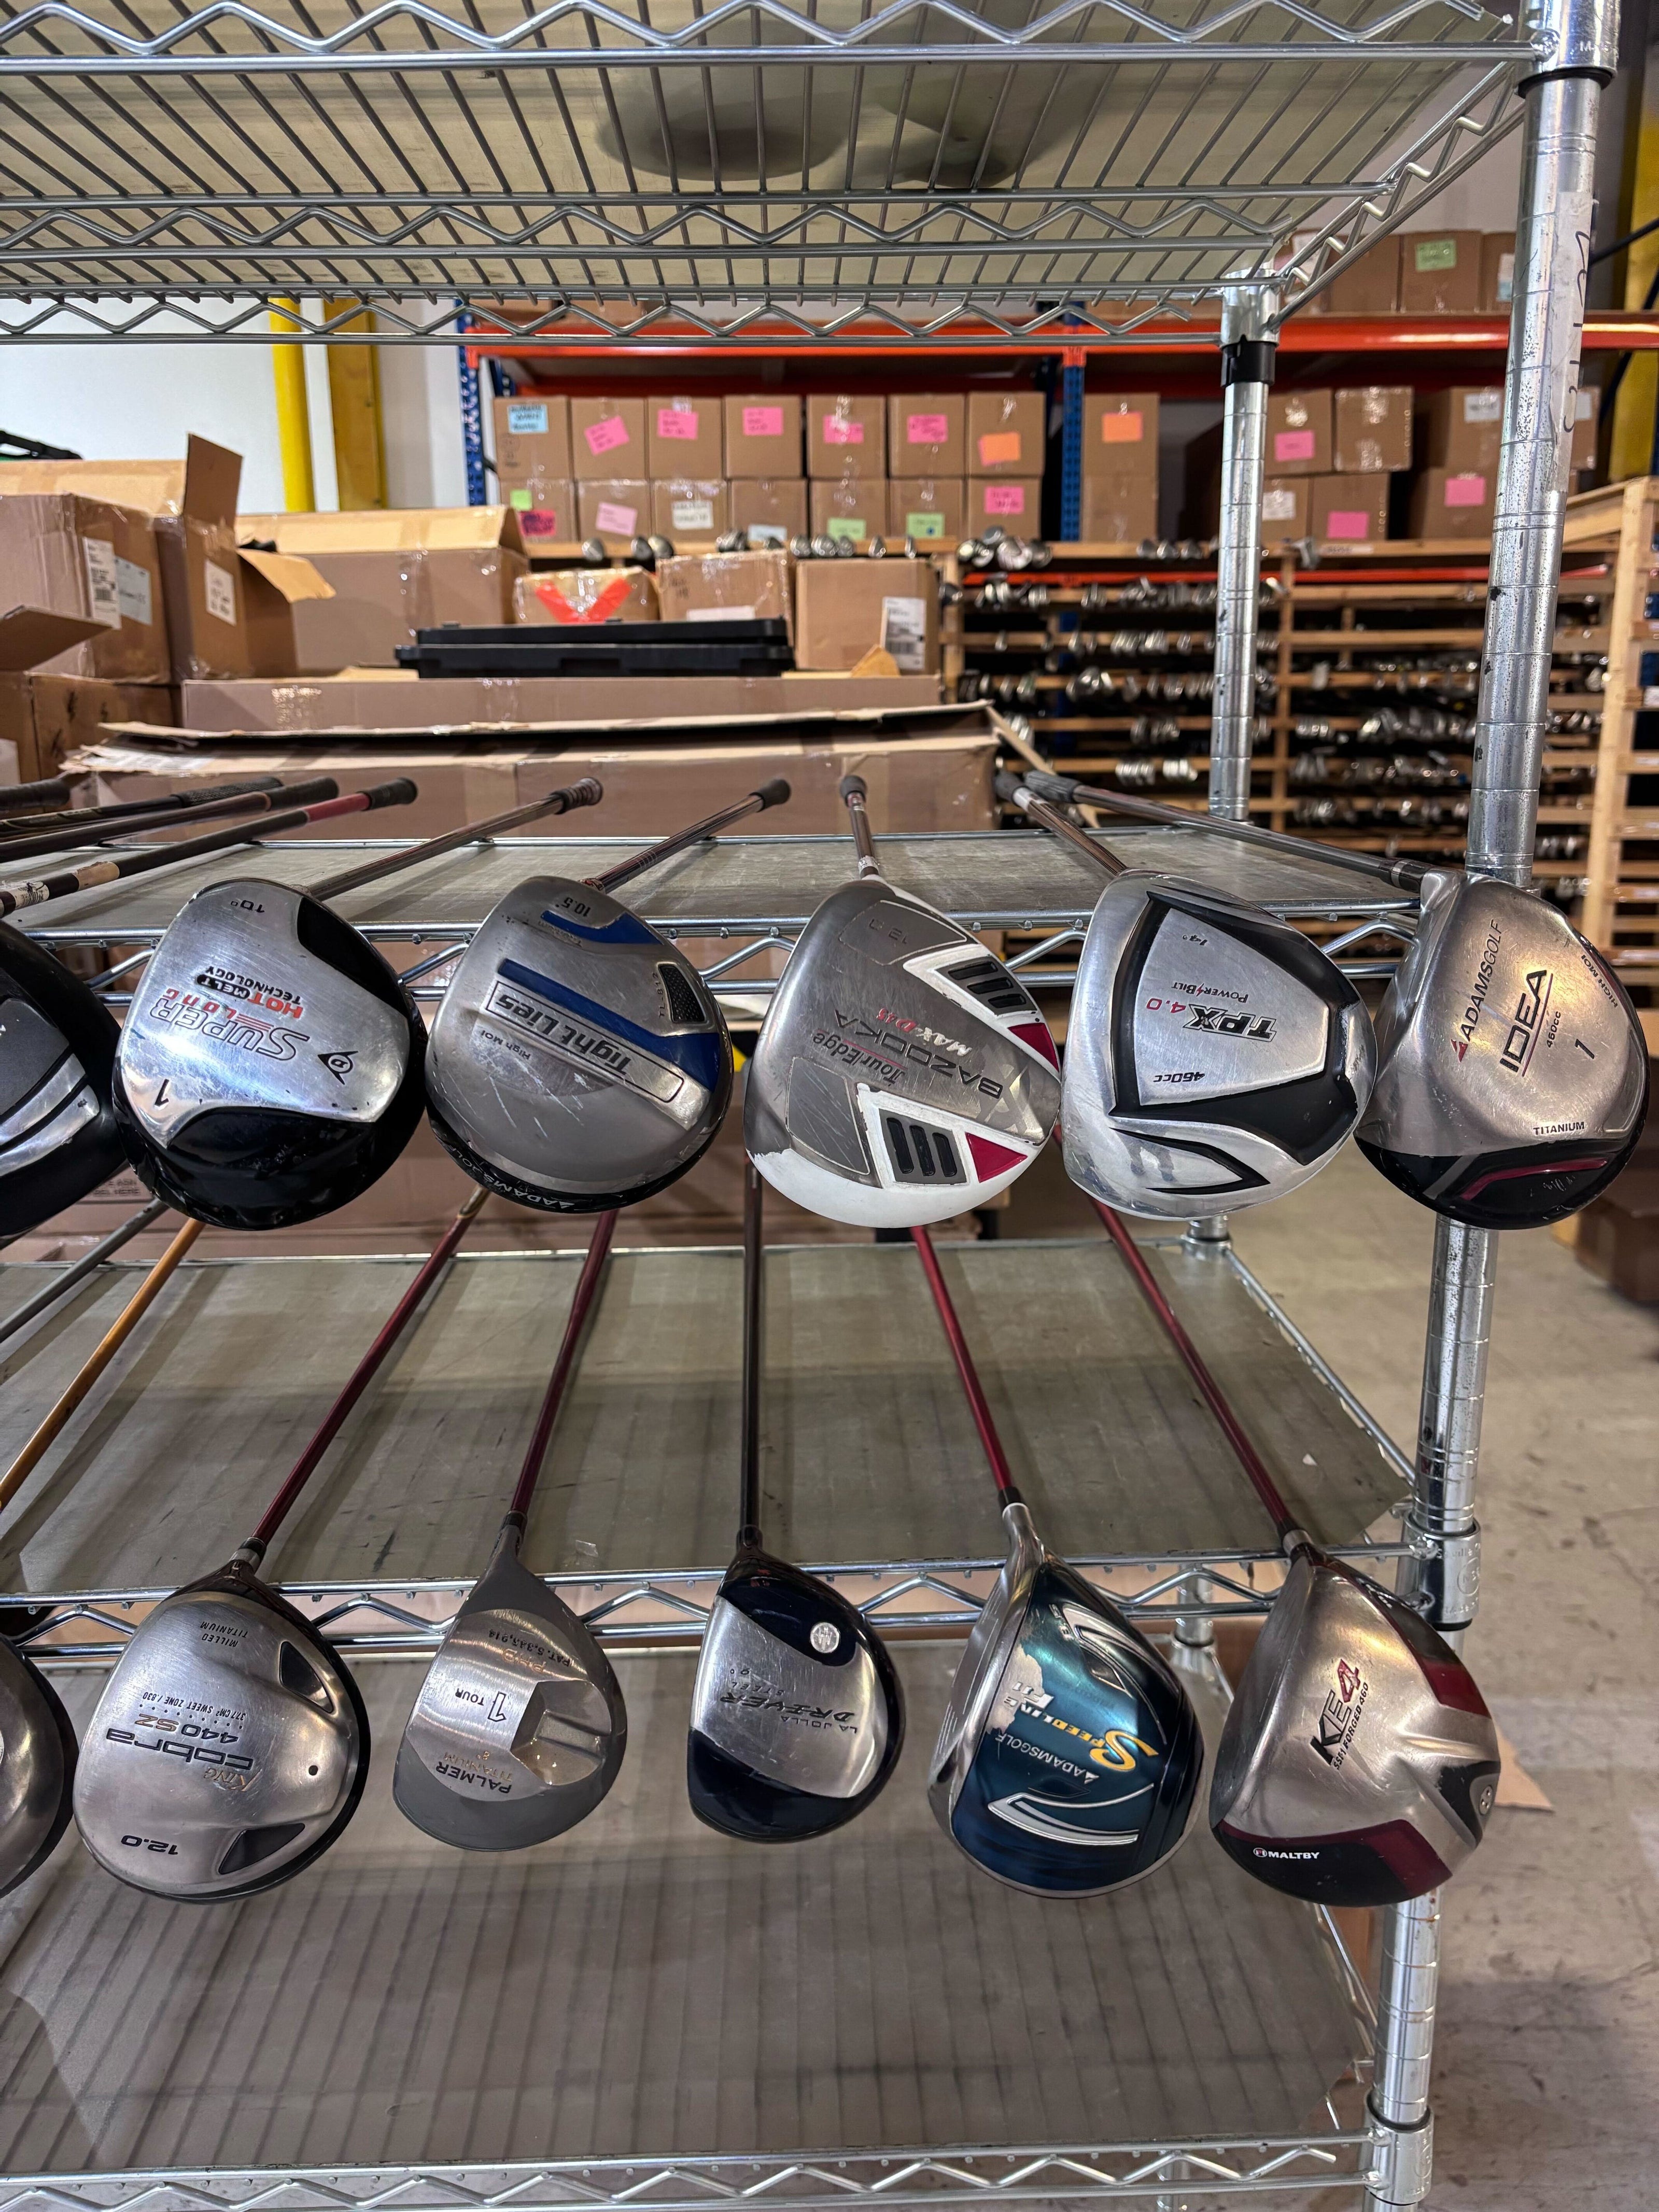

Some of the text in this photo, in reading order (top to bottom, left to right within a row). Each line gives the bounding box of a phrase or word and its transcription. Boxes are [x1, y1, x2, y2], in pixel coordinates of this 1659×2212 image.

[206, 966, 302, 1004] TECHNOLOGY
[1582, 954, 1618, 1008] HIGH MOI
[203, 977, 304, 1019] HOT MELT
[150, 999, 310, 1061] SUPER
[496, 994, 631, 1074] Tight Lies
[1146, 998, 1277, 1042] TPX 4.0
[1500, 970, 1547, 1073] IDEA
[834, 1009, 1003, 1099] BAZOOKA
[1575, 1038, 1596, 1060] 1
[154, 1079, 170, 1108] 1
[1533, 1122, 1585, 1135] TITANIUM
[200, 1621, 248, 1638] TITANIUM
[202, 1633, 238, 1648] MILLED
[164, 1697, 185, 1709] ZONE
[732, 1681, 784, 1696] STEEL
[186, 1701, 214, 1715] SWEET
[455, 1687, 507, 1722] 1 TOUR
[720, 1692, 855, 1722] DRIVER
[1343, 1705, 1362, 1749] FORGED
[1360, 1682, 1369, 1704] 460
[135, 1713, 239, 1744] 440 SZ
[781, 1715, 858, 1734] LA JOLLA
[106, 1728, 254, 1770] cobra
[436, 1761, 512, 1794] PALMER
[444, 1752, 513, 1783] TITANIUM
[121, 1835, 178, 1855] 12.0
[1268, 1851, 1320, 1859] MALTBY
